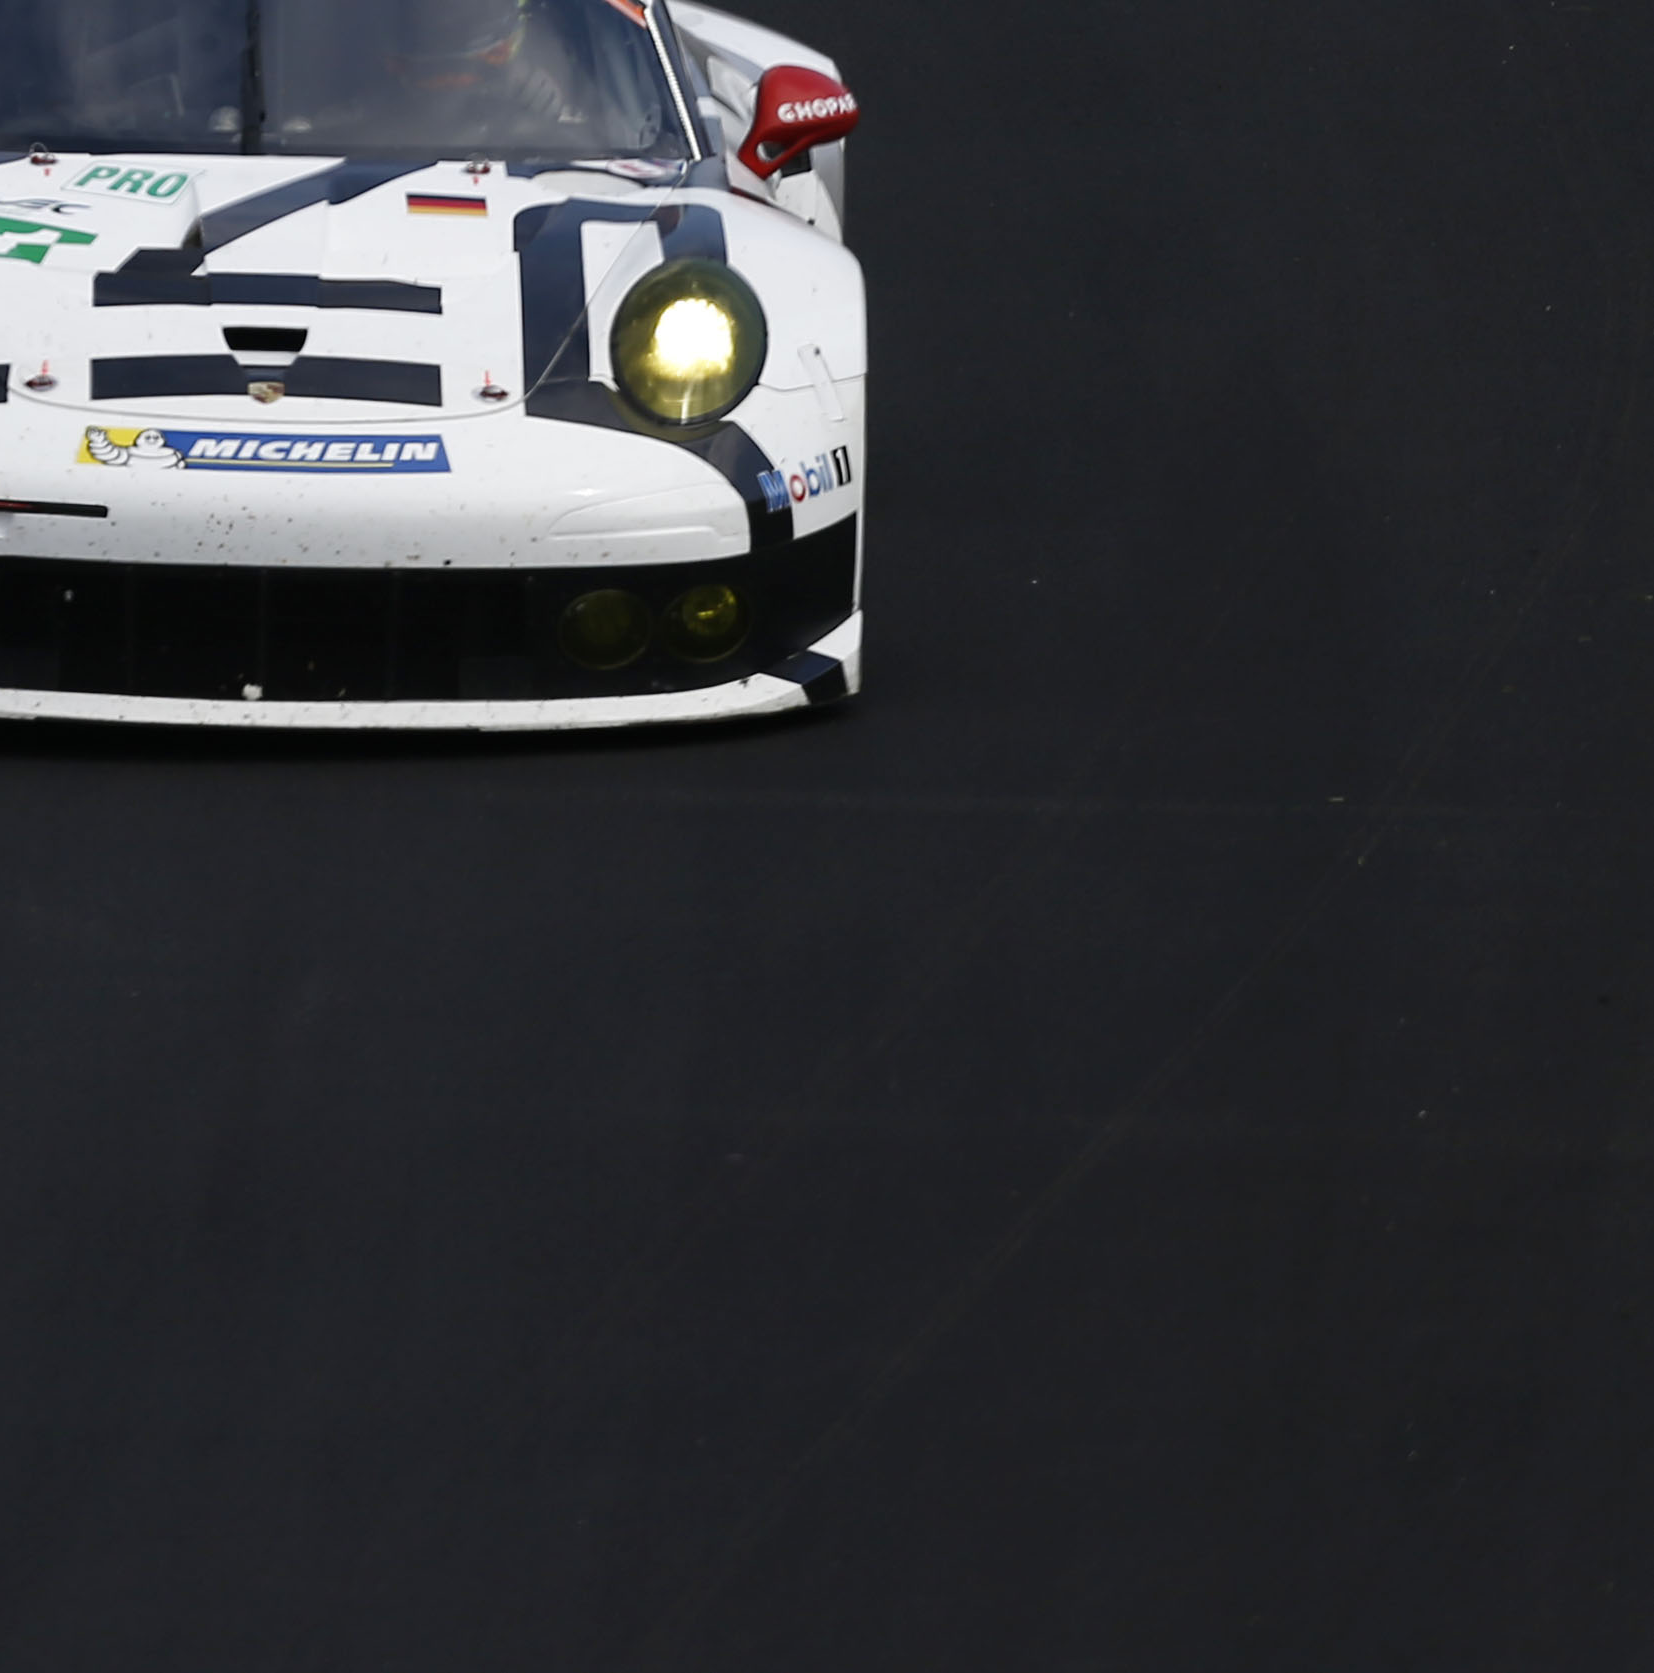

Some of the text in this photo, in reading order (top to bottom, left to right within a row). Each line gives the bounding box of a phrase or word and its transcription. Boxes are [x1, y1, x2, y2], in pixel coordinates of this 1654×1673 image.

[74, 165, 184, 198] PRO
[187, 437, 439, 462] MICHELIN
[756, 444, 852, 514] Mobil 1
